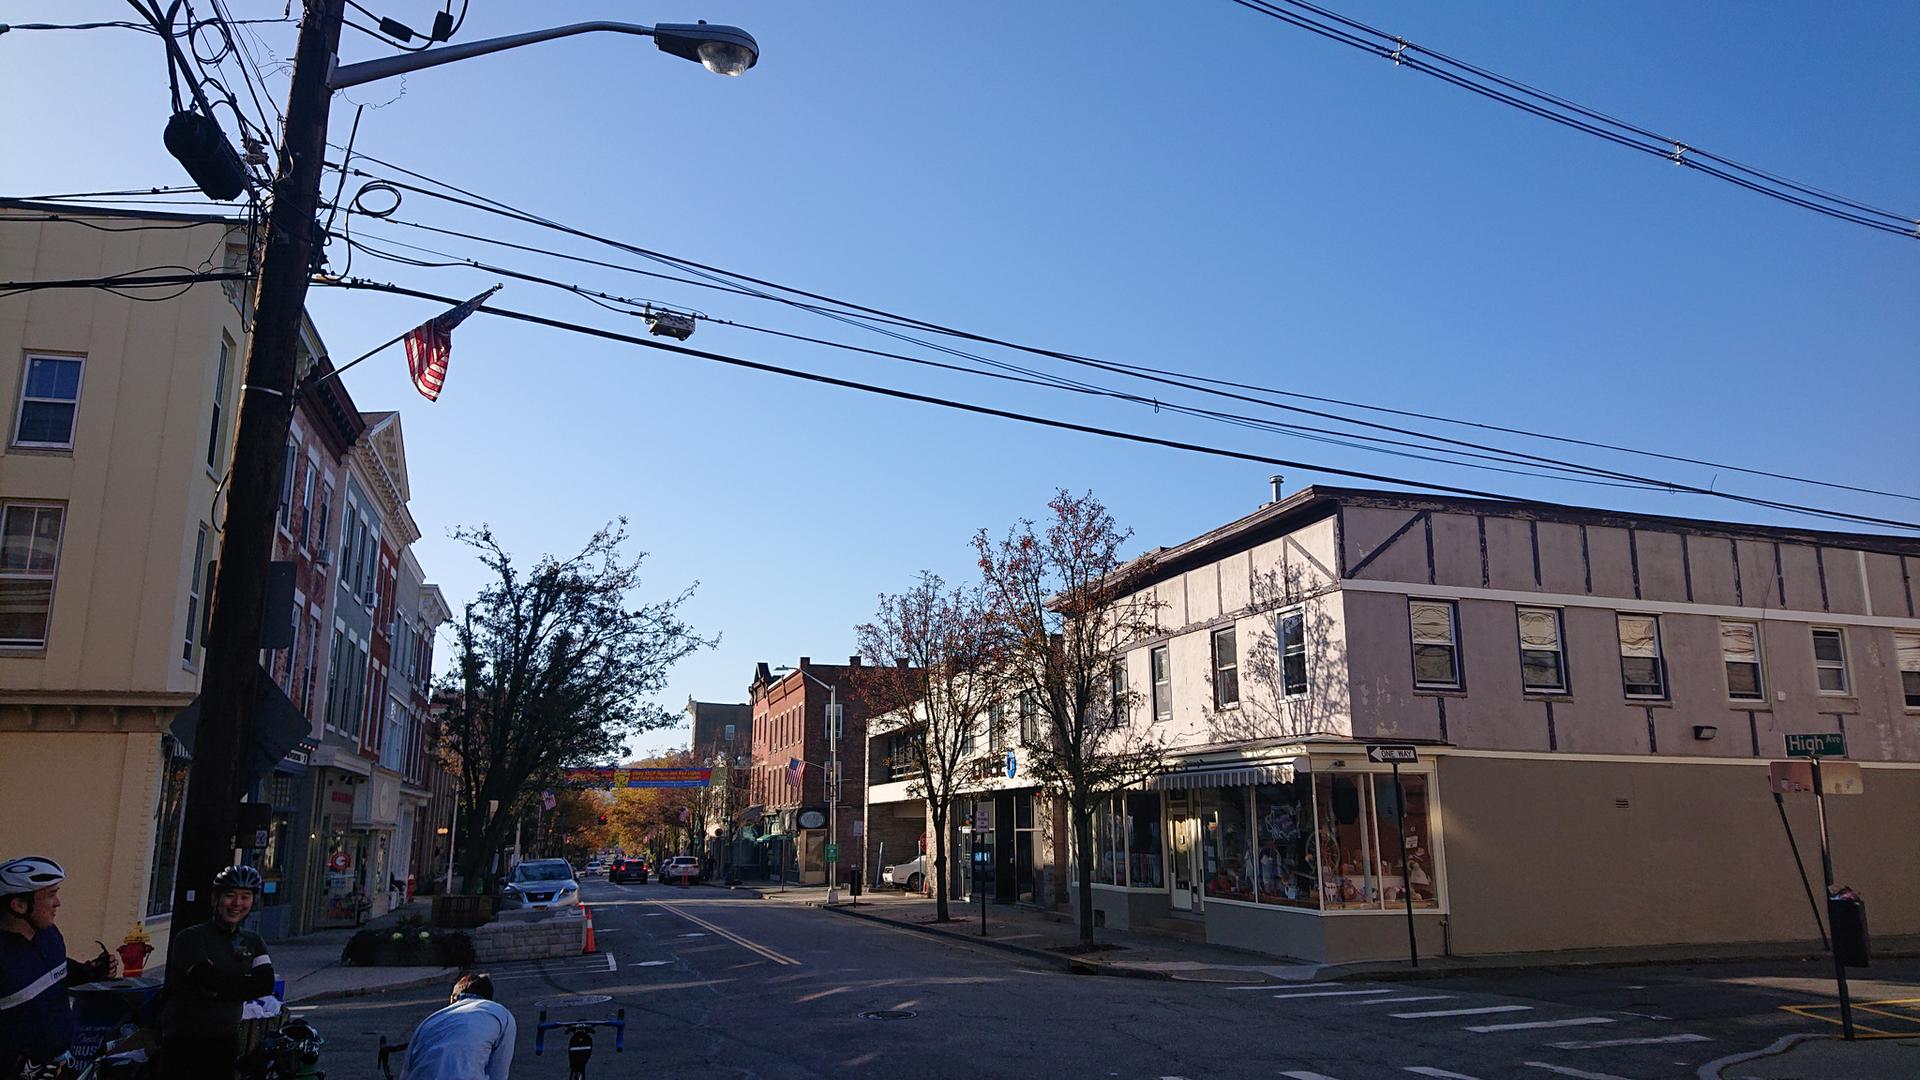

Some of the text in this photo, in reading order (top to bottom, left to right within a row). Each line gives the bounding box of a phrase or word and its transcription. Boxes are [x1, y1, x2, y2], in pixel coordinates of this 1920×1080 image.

[1790, 735, 1840, 754] High Ave
[1398, 750, 1412, 758] WAY
